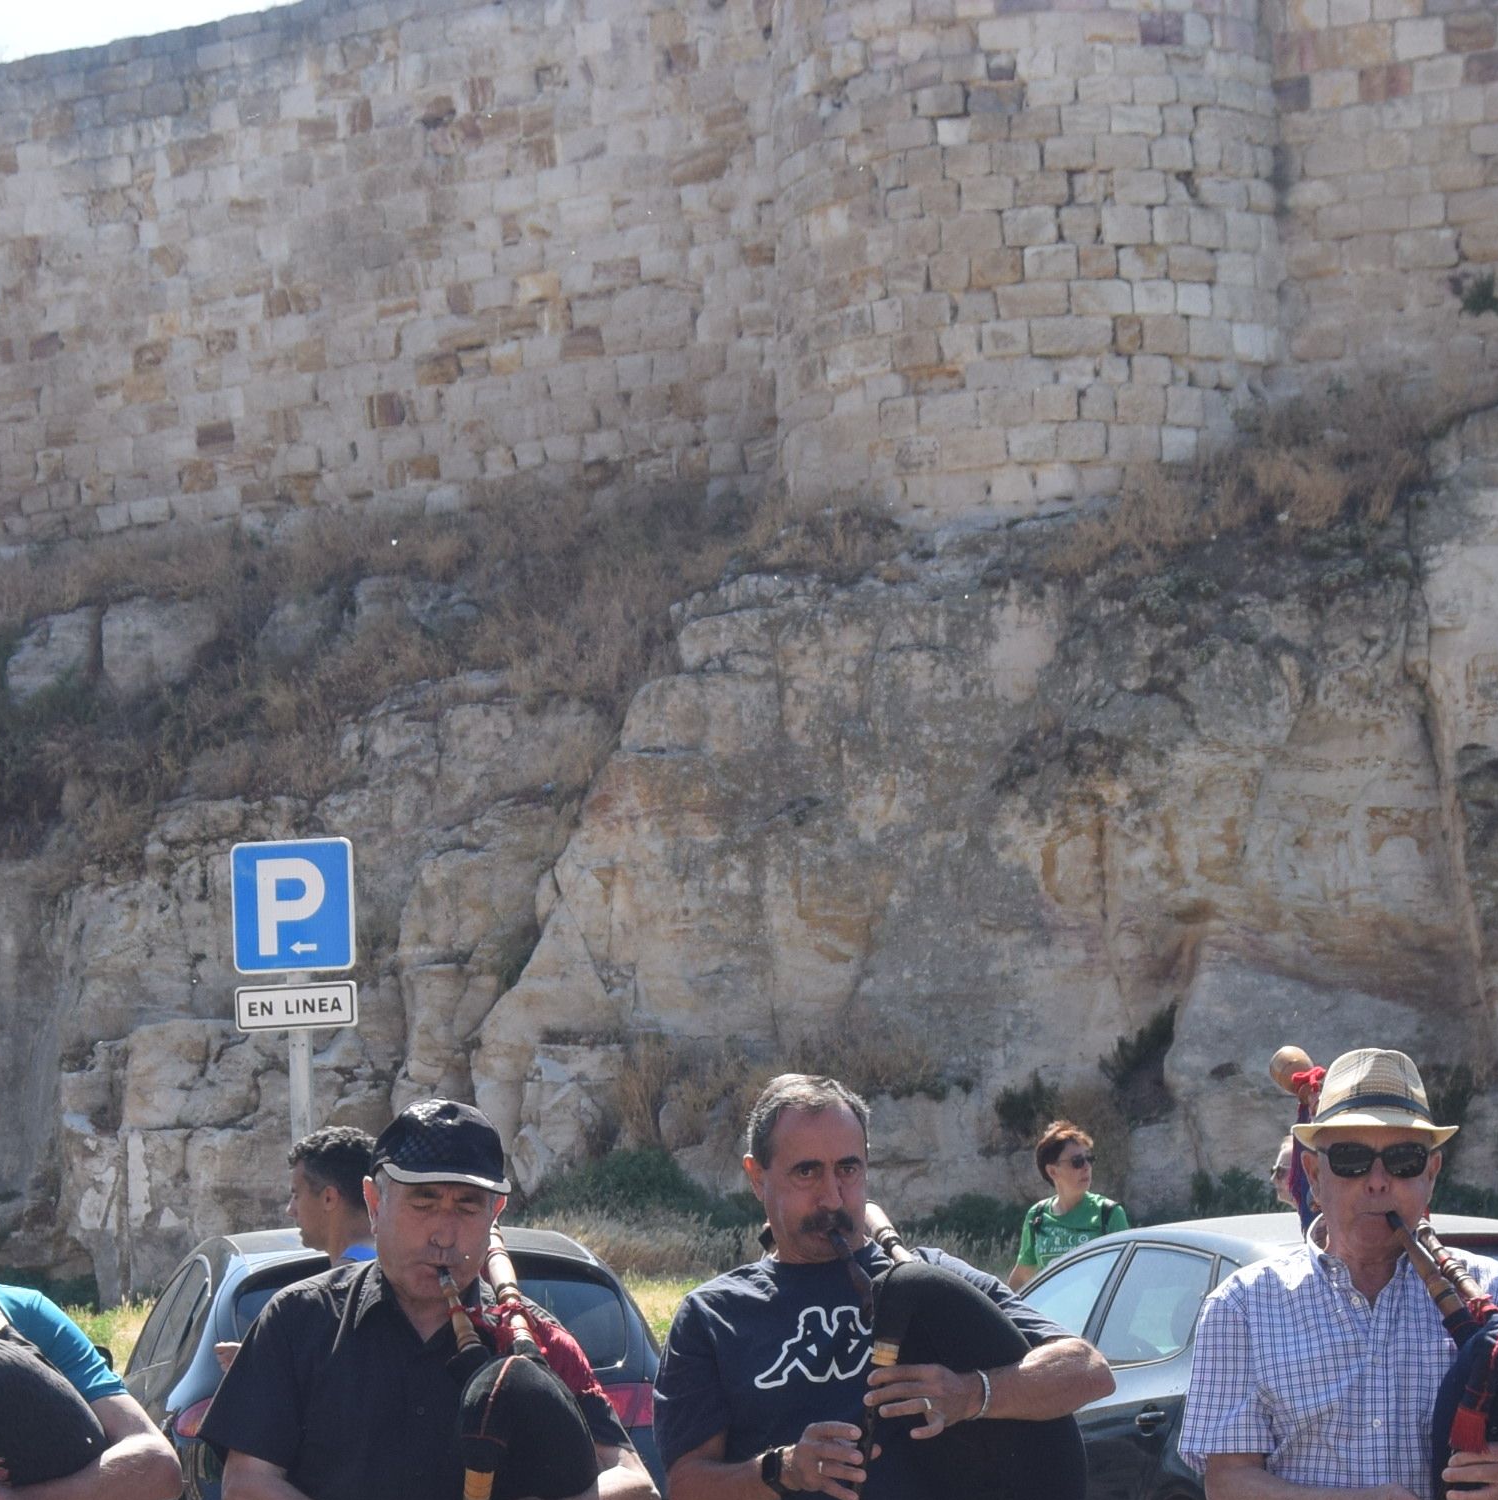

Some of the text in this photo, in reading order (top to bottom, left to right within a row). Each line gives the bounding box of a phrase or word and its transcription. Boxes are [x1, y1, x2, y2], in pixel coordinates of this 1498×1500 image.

[256, 858, 325, 956] P
[248, 997, 342, 1016] EN LINEA
